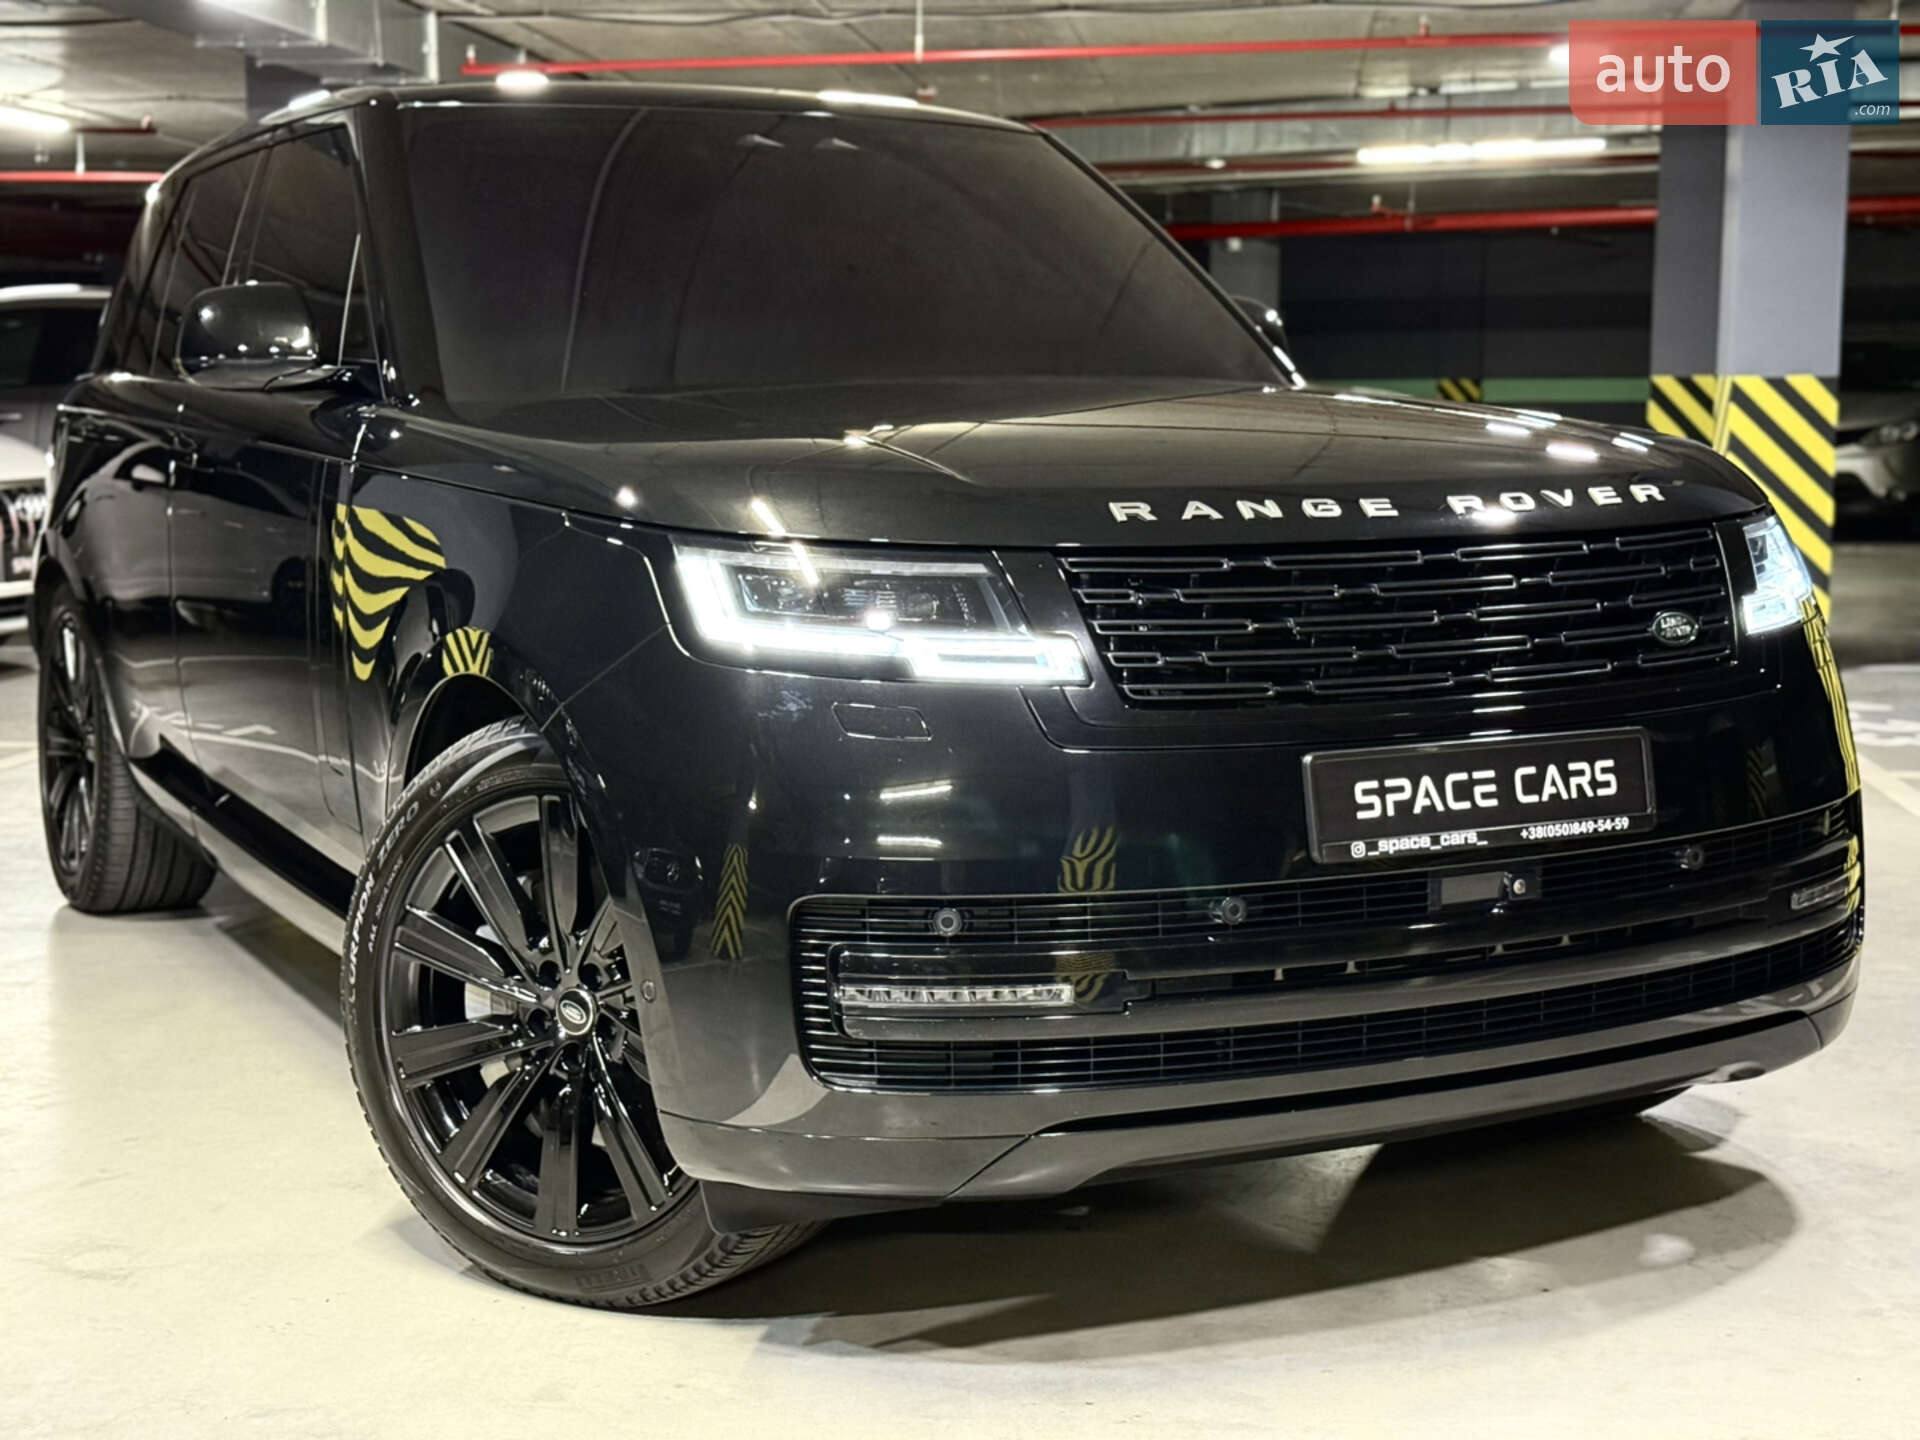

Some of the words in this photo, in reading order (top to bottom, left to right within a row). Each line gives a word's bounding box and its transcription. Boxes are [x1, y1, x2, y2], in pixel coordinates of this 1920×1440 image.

[1108, 498, 1399, 522] RANGE
[1446, 484, 1666, 516] ROVER
[1354, 769, 1499, 820] SPACE
[1513, 758, 1619, 804] CARS
[1520, 816, 1630, 840] +38(050)849-54-59
